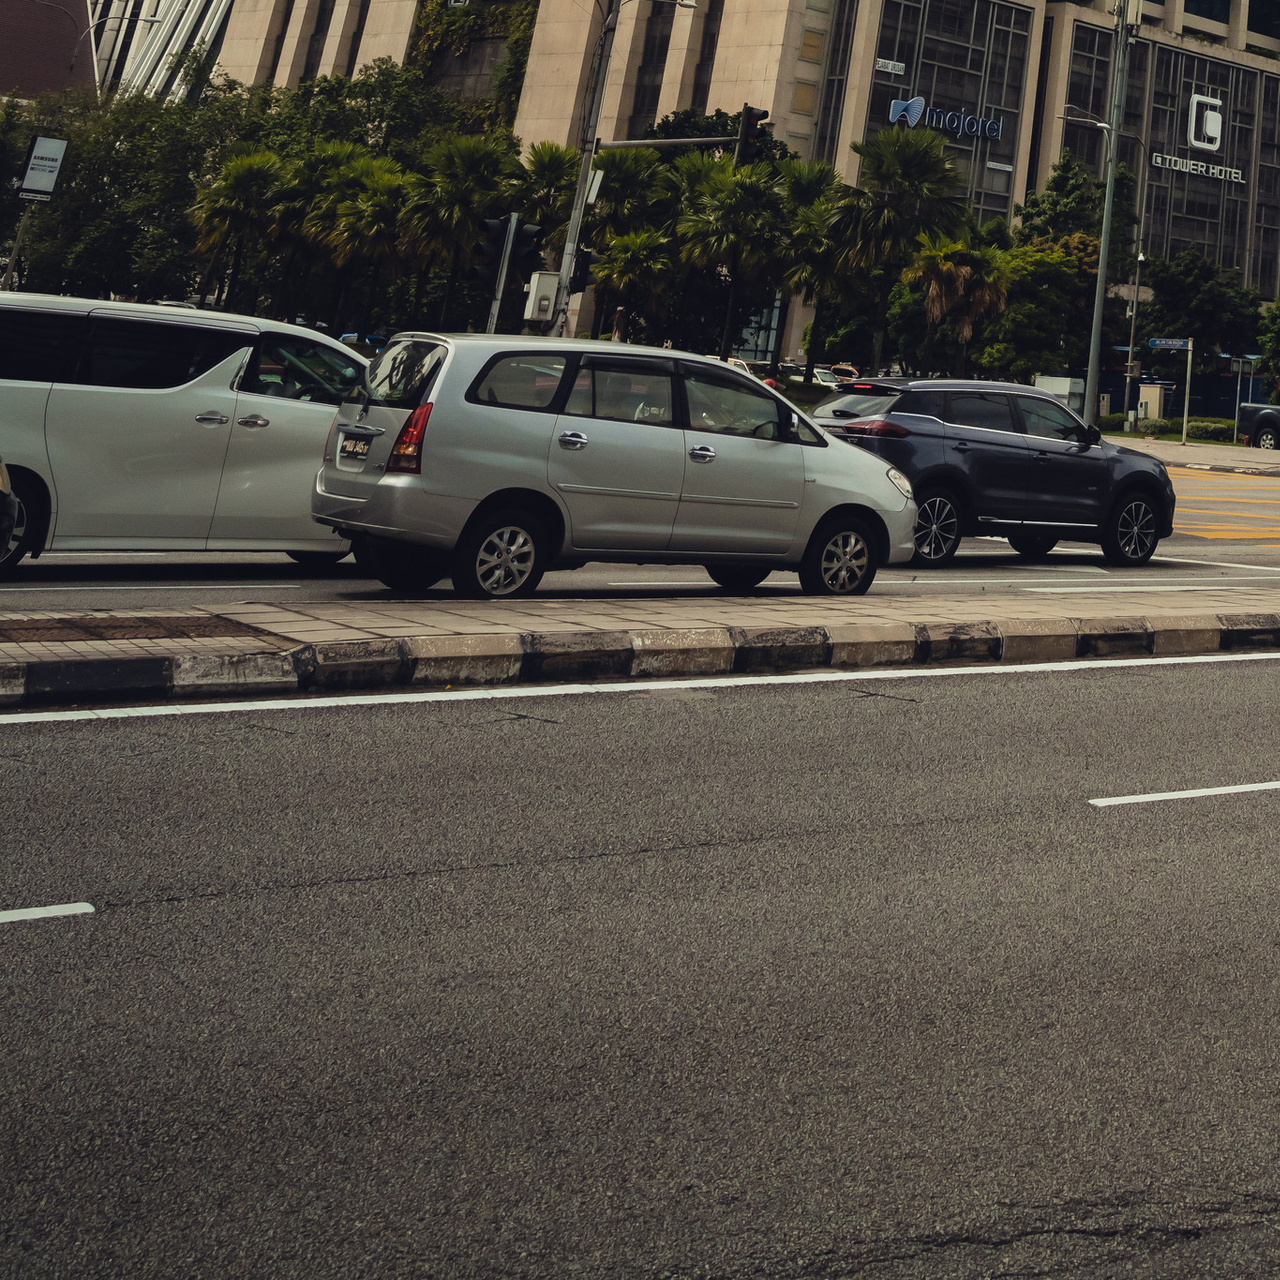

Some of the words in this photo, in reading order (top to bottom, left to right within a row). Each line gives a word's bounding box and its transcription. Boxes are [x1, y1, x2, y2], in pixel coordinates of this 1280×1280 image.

[925, 106, 1005, 141] majorel
[1164, 154, 1208, 176] TOWER
[1208, 165, 1247, 184] HOTEL
